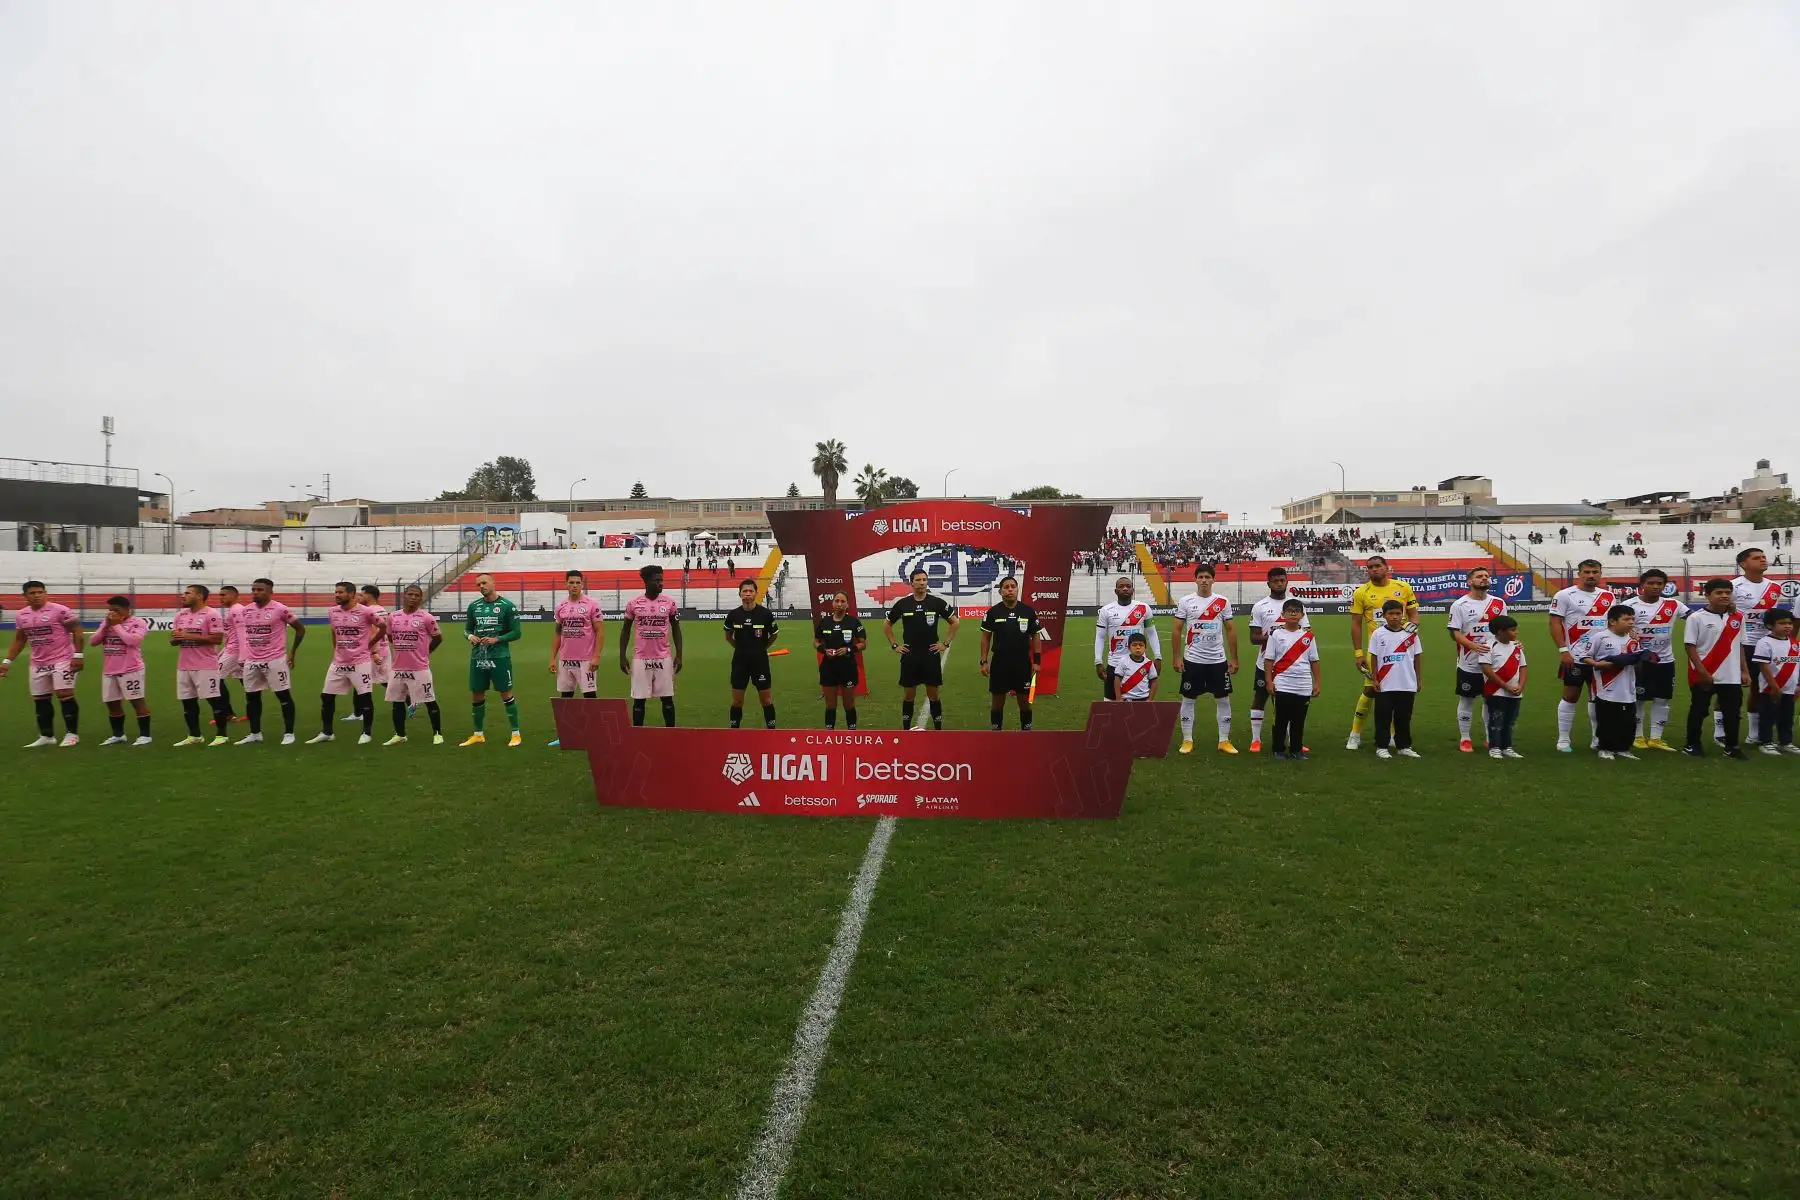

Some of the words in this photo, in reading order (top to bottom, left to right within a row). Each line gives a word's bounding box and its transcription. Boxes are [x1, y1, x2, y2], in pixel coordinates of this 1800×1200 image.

[941, 519, 1001, 531] betsson
[1417, 574, 1456, 584] CAMISETA
[1438, 581, 1459, 590] TODO
[1460, 581, 1470, 589] EL
[1291, 586, 1339, 599] ORIENTE
[1382, 654, 1406, 663] 1XBET
[126, 680, 140, 691] 22
[209, 679, 216, 688] 3
[805, 735, 884, 745] CLAUSURA
[855, 757, 972, 781] betsson
[784, 794, 837, 807] betsson
[865, 794, 898, 804] SPORADE
